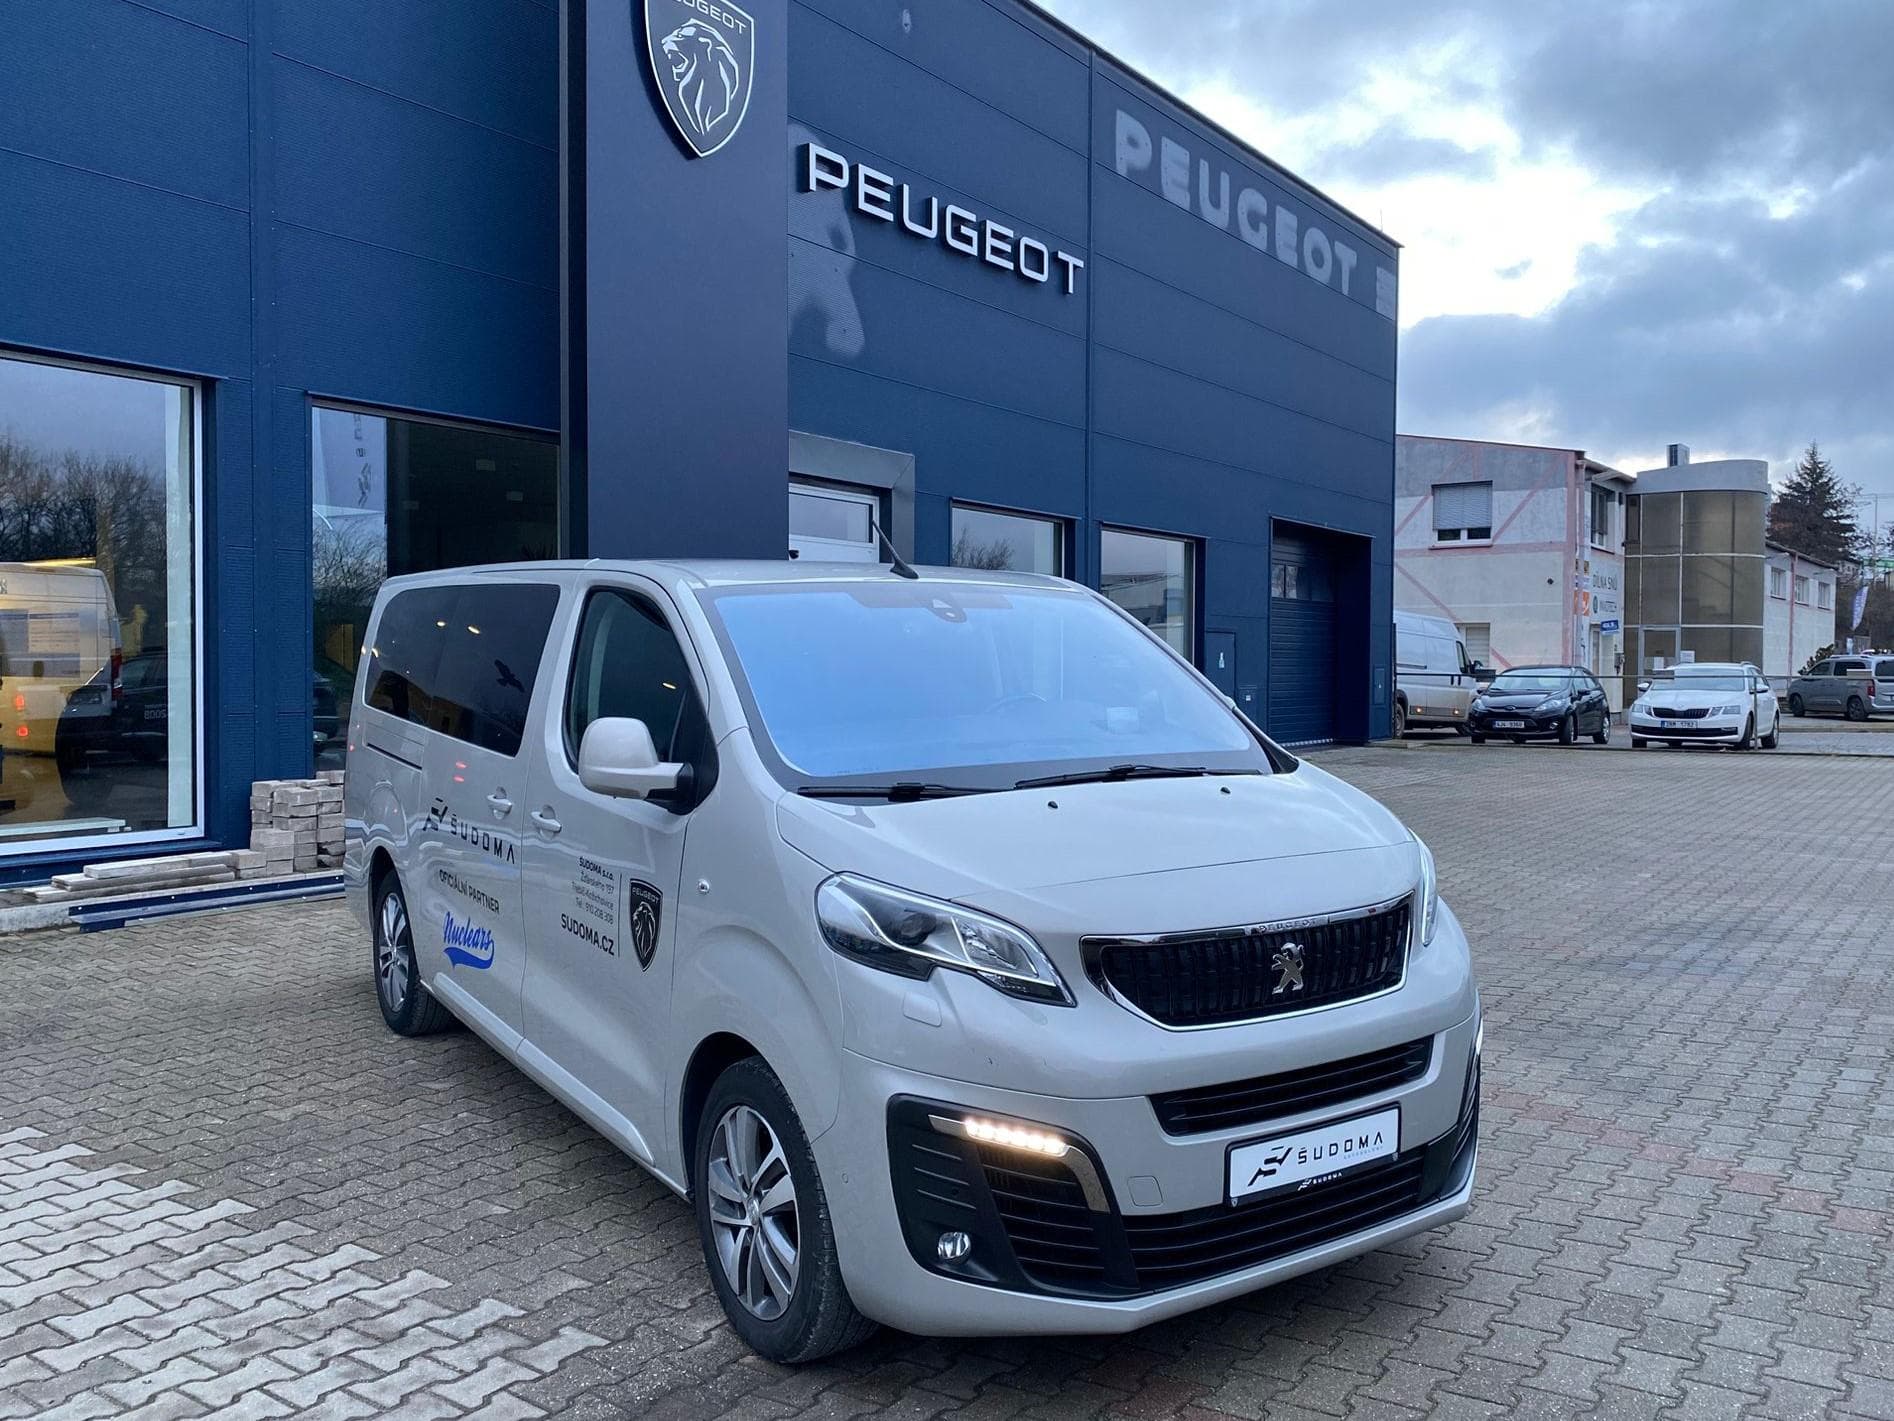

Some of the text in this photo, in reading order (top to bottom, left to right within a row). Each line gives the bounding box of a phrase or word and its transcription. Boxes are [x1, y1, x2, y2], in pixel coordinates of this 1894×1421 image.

[807, 141, 1085, 296] PEUGEOT
[1115, 109, 1357, 296] PEUGEOT
[468, 885, 500, 915] PARTNER
[632, 887, 659, 904] PEUGEOT
[443, 911, 495, 951] Nuclears
[561, 912, 615, 956] SUDOMA.CZ
[1259, 919, 1316, 933] PEUGEOT
